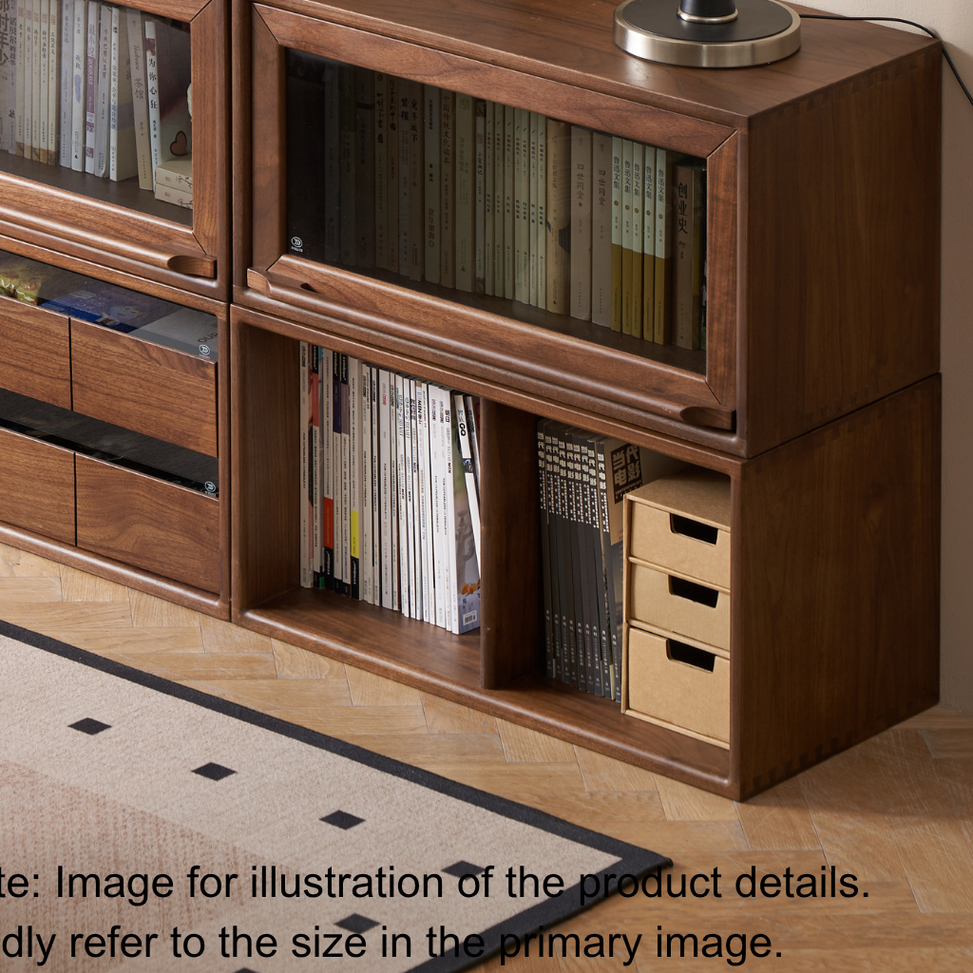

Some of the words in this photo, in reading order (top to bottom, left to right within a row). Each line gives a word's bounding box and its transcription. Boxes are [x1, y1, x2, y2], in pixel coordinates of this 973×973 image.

[148, 58, 158, 109] 为你心狂
[443, 95, 451, 164] 中国传统文化读本
[577, 163, 585, 203] 四世同堂
[598, 169, 607, 206] 四世同堂
[645, 165, 653, 199] 鲁迅文集
[677, 182, 688, 234] 创业史
[612, 445, 639, 471] 当代
[614, 460, 641, 486] 电影
